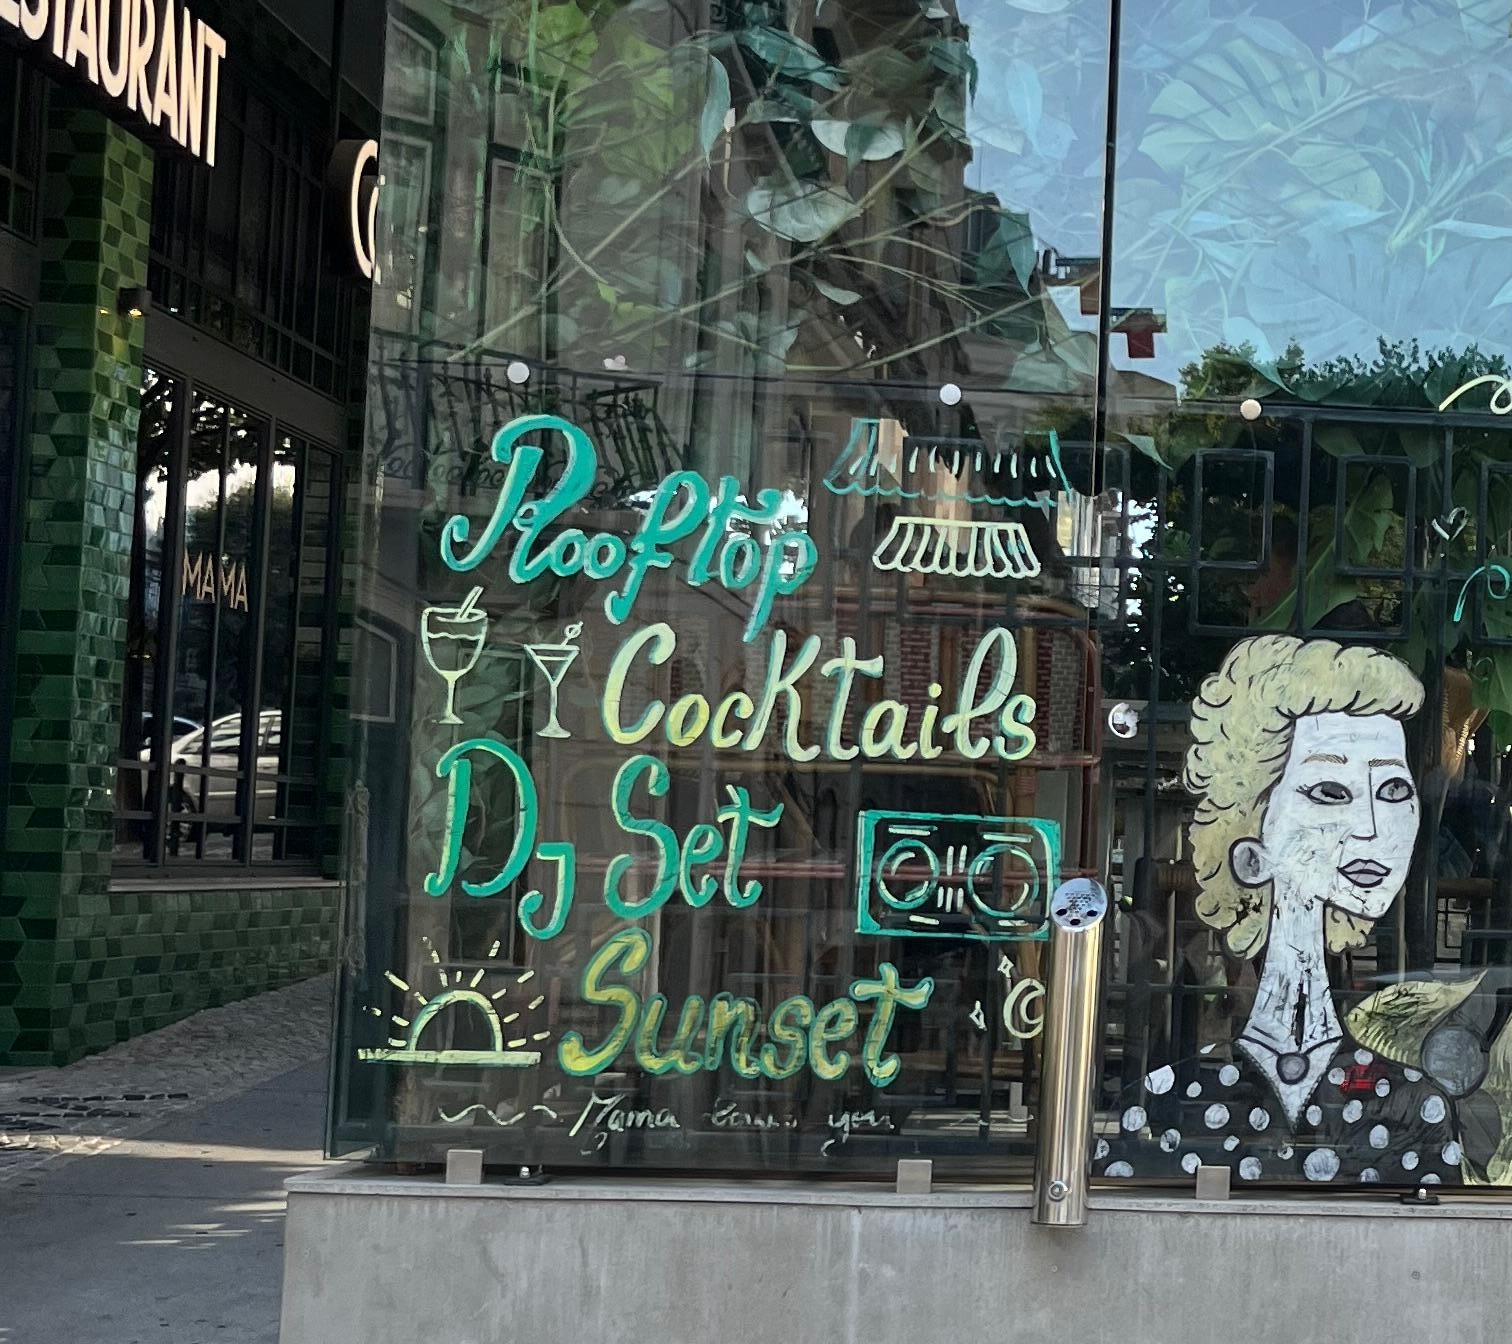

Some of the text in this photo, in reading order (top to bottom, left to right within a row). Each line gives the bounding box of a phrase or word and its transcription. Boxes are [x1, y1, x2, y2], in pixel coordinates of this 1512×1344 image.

[181, 546, 249, 613] MAMA
[441, 413, 819, 642] Rooftop
[604, 754, 784, 918] Set
[558, 927, 934, 1088] Sunset
